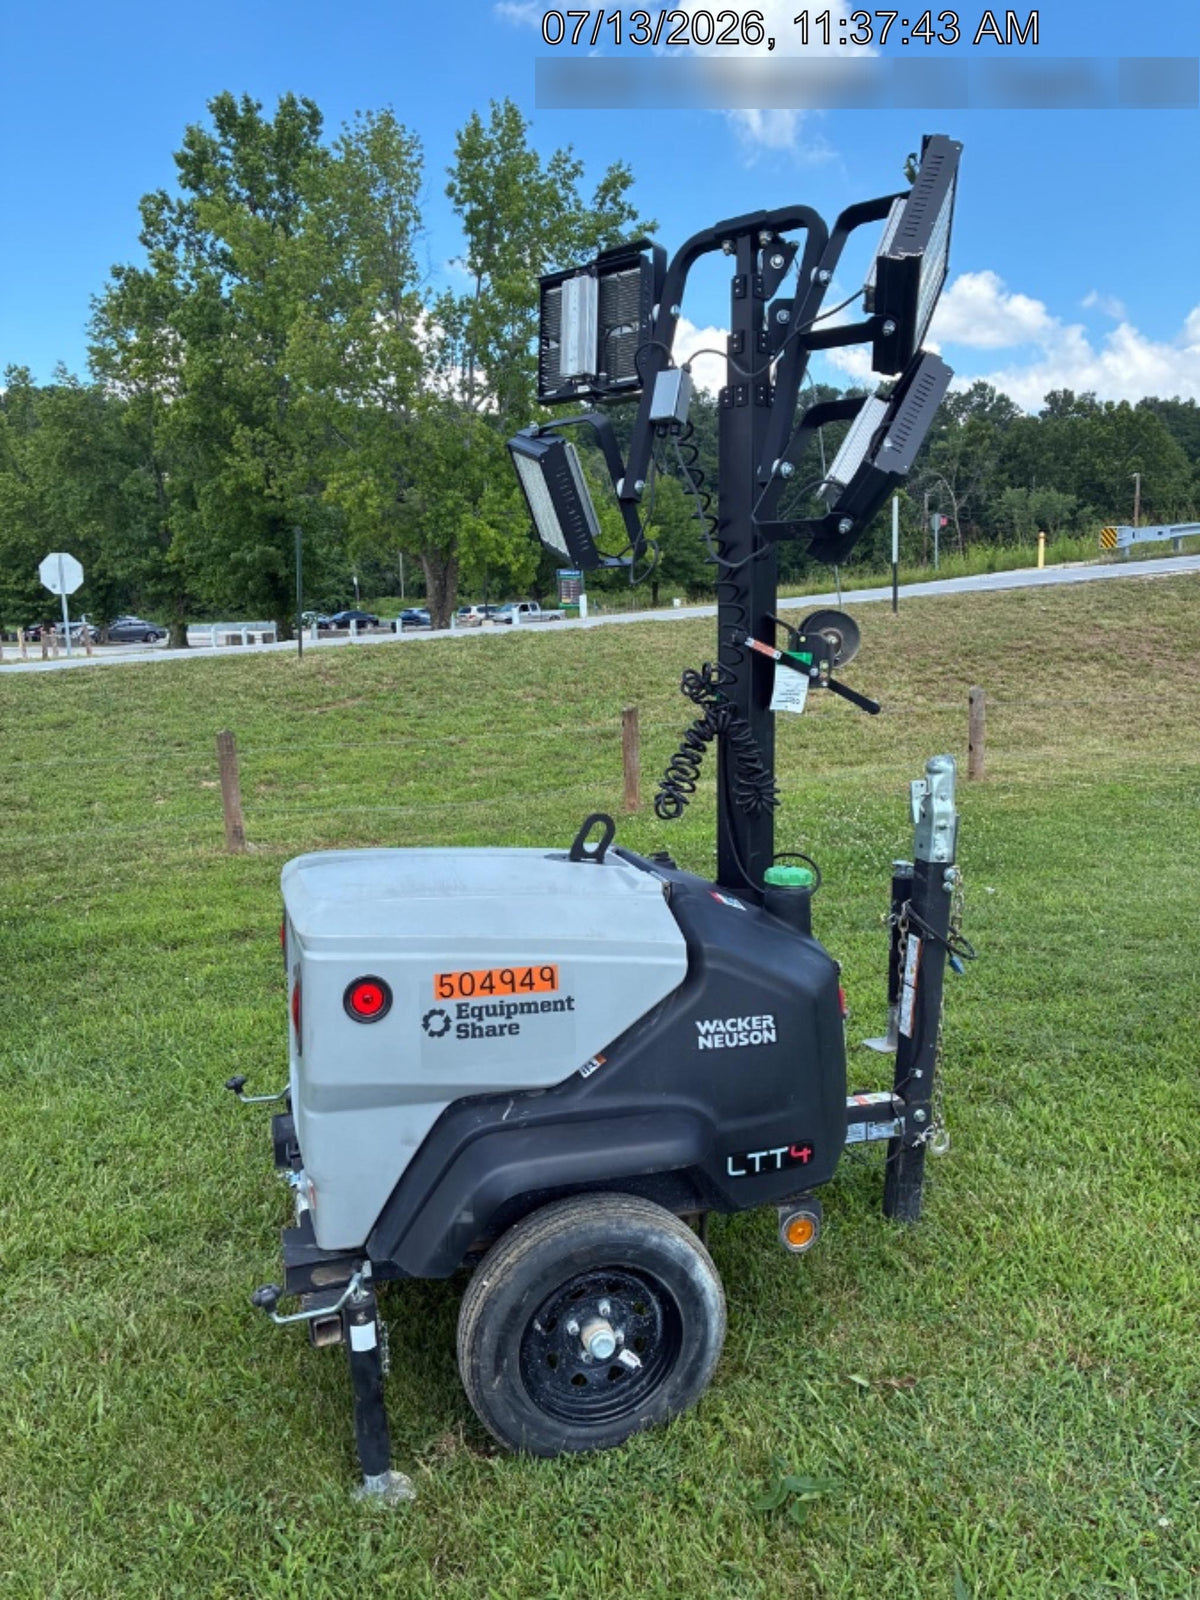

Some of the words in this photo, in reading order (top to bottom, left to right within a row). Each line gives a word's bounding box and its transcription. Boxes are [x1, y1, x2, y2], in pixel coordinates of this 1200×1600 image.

[438, 965, 556, 999] 504949
[456, 995, 575, 1022] Equipment
[456, 1022, 520, 1039] Share
[695, 1015, 776, 1034] WACKER
[698, 1028, 777, 1050] NEUSON
[727, 1145, 812, 1177] LTT4
